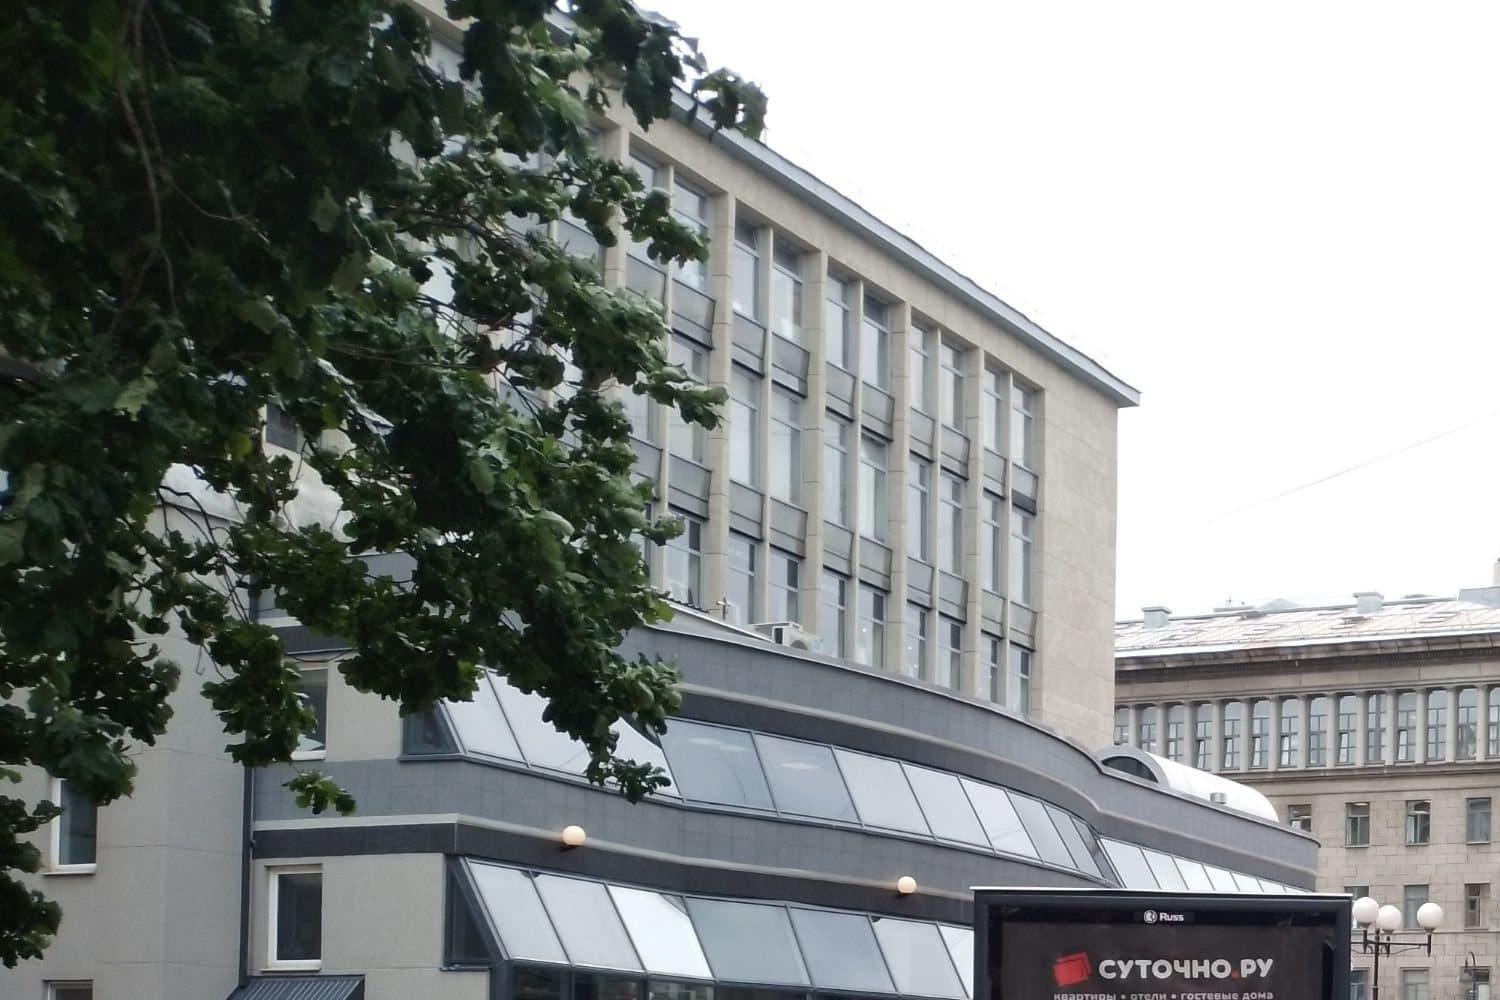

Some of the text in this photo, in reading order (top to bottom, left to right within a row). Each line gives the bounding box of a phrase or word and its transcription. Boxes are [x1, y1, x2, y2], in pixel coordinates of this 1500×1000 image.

[1159, 912, 1184, 921] Russ
[1099, 958, 1274, 980] СУТОЧНО.РУ
[1130, 992, 1167, 1000] отели
[1181, 991, 1239, 1000] гостевые
